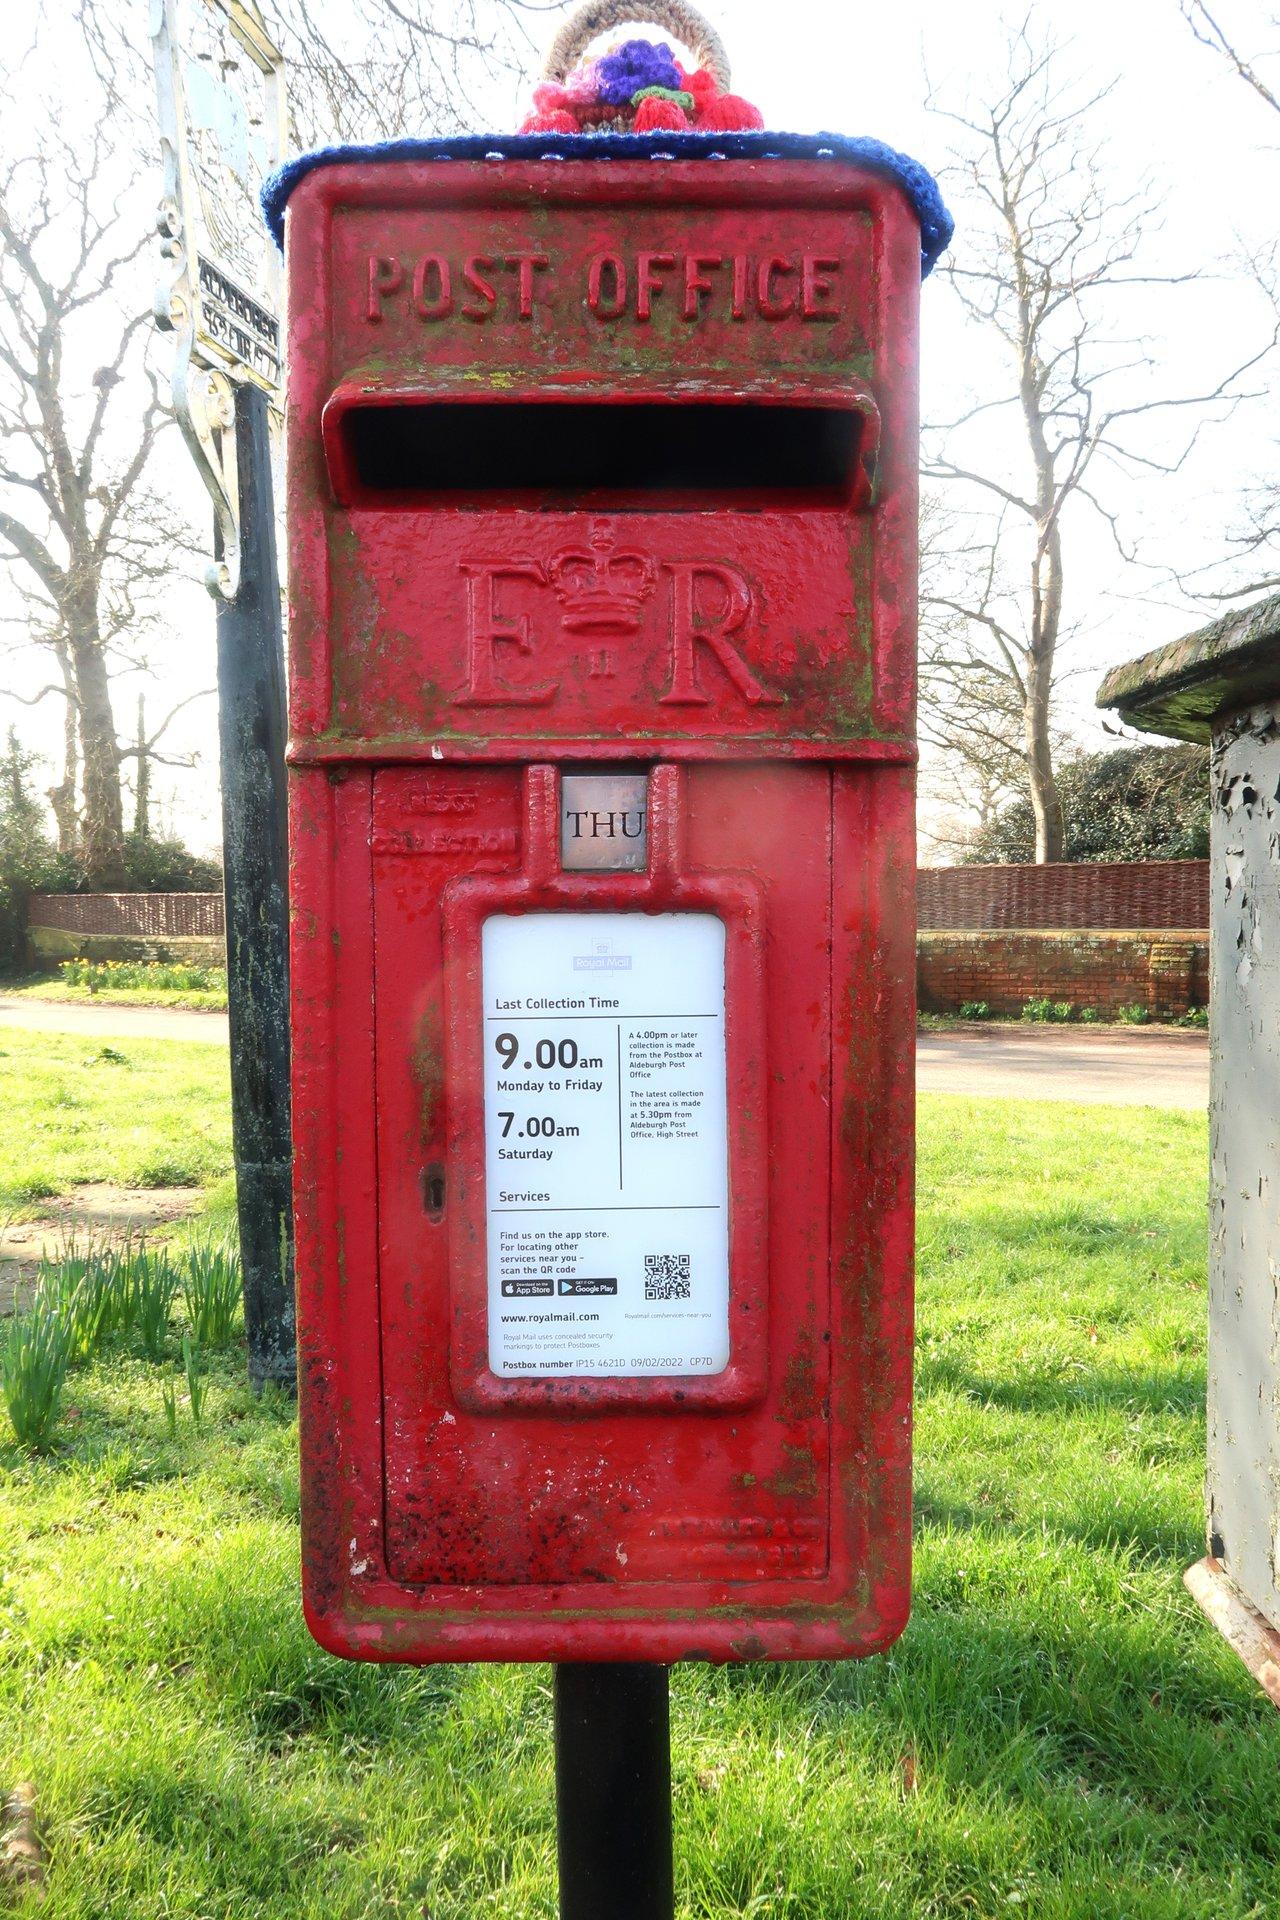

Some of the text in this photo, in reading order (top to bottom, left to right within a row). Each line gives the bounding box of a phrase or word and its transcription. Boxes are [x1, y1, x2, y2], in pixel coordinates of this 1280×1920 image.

[365, 252, 840, 324] POST OFFICE
[453, 558, 560, 707] E
[658, 560, 785, 706] R
[567, 811, 646, 838] THU
[576, 958, 629, 969] Royal Mail
[496, 997, 619, 1009] Last Collection Time
[636, 1031, 668, 1040] 4.00pm
[495, 1033, 602, 1070] 9.00am
[630, 1061, 666, 1069] Aldeburgh
[498, 1079, 602, 1093] Monday to Friday
[641, 1111, 672, 1119] 5.30pm
[498, 1112, 579, 1138] 7.00am
[657, 1131, 673, 1139] High
[499, 1149, 553, 1161] Saturday
[500, 1191, 550, 1202] Services
[501, 1242, 578, 1252] For locating other
[501, 1255, 535, 1263] services
[524, 1266, 537, 1274] the
[541, 1266, 553, 1274] QR
[600, 1285, 614, 1293] Play
[501, 1312, 599, 1323] www.royalmail.com
[503, 1361, 536, 1369] Postbox
[576, 1359, 594, 1368] IP15
[598, 1359, 625, 1367] 4621D
[631, 1358, 683, 1367] 09/02/2022
[690, 1357, 712, 1365] CP7D
